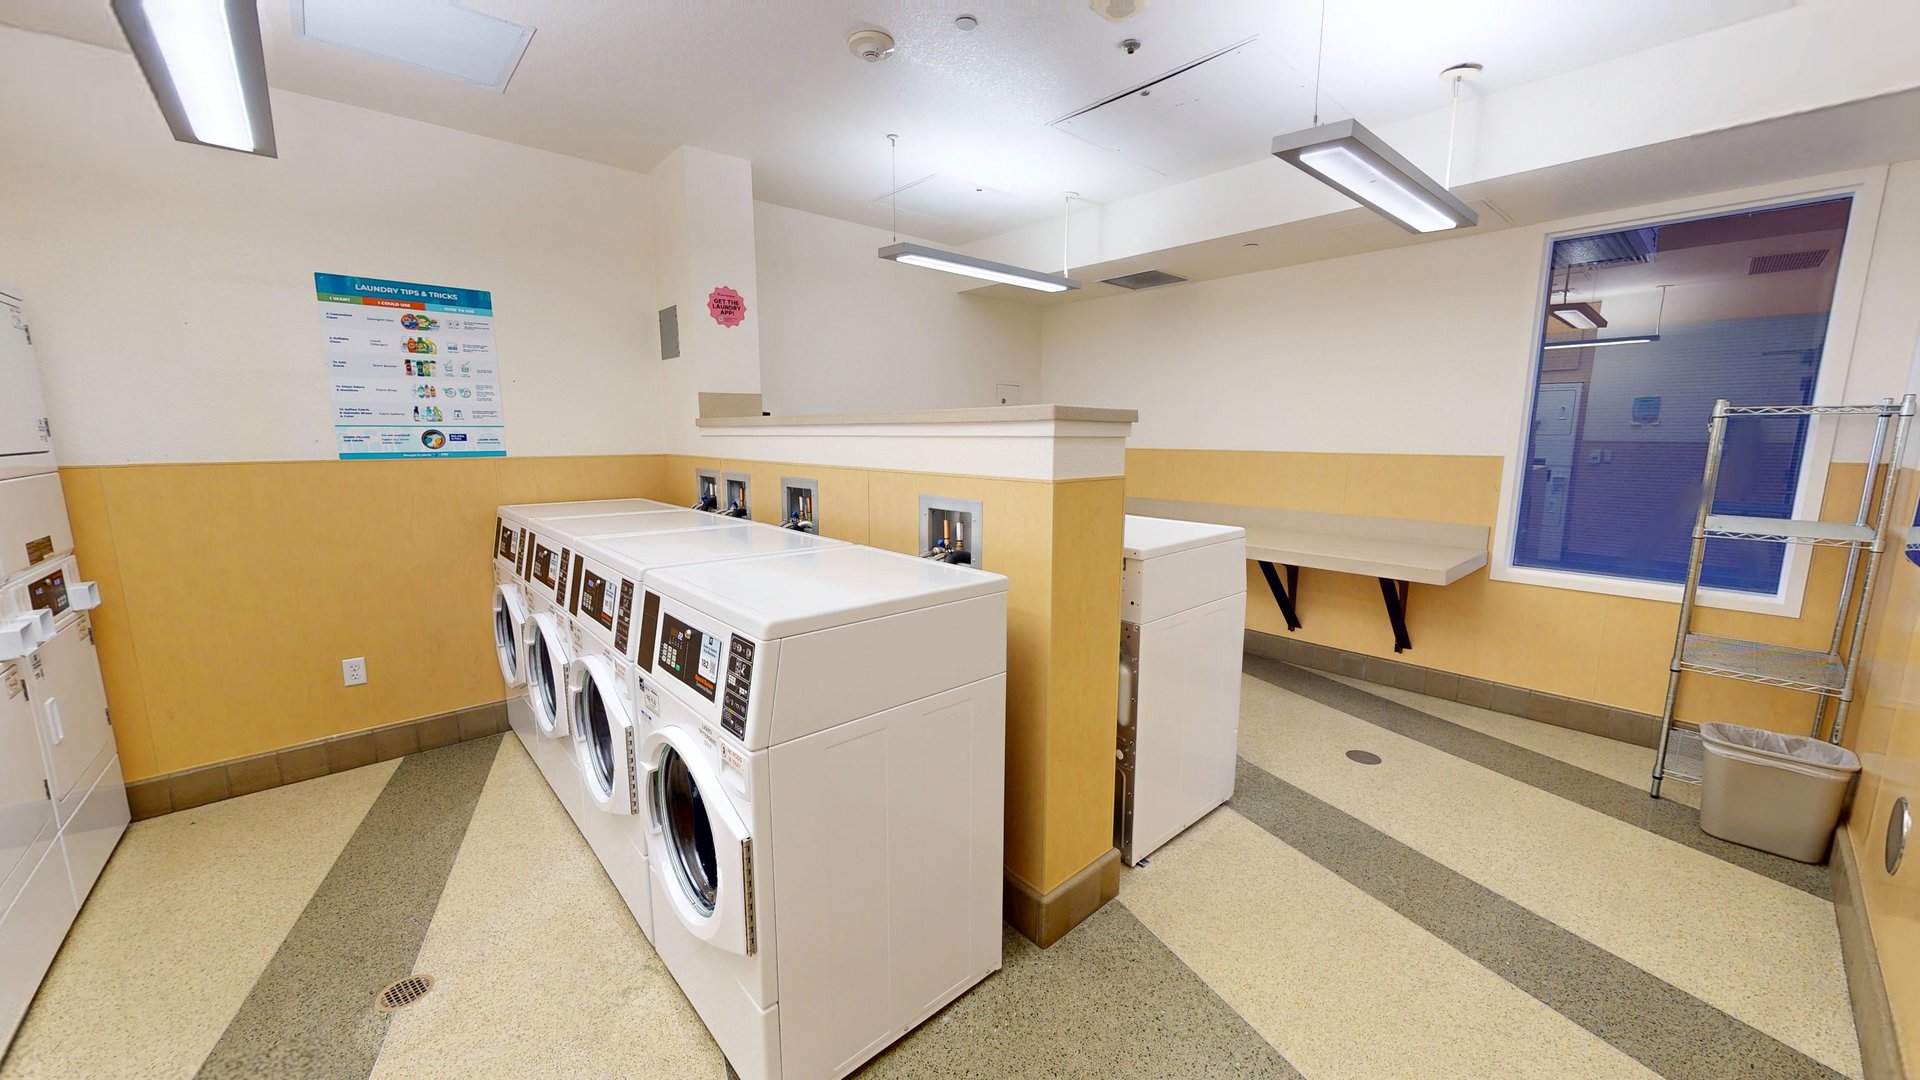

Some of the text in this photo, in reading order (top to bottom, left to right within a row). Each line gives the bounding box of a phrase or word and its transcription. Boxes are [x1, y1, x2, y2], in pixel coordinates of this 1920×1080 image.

[355, 284, 398, 294] LAUNDRY
[400, 288, 419, 296] TIPS
[429, 291, 458, 300] TRICKS
